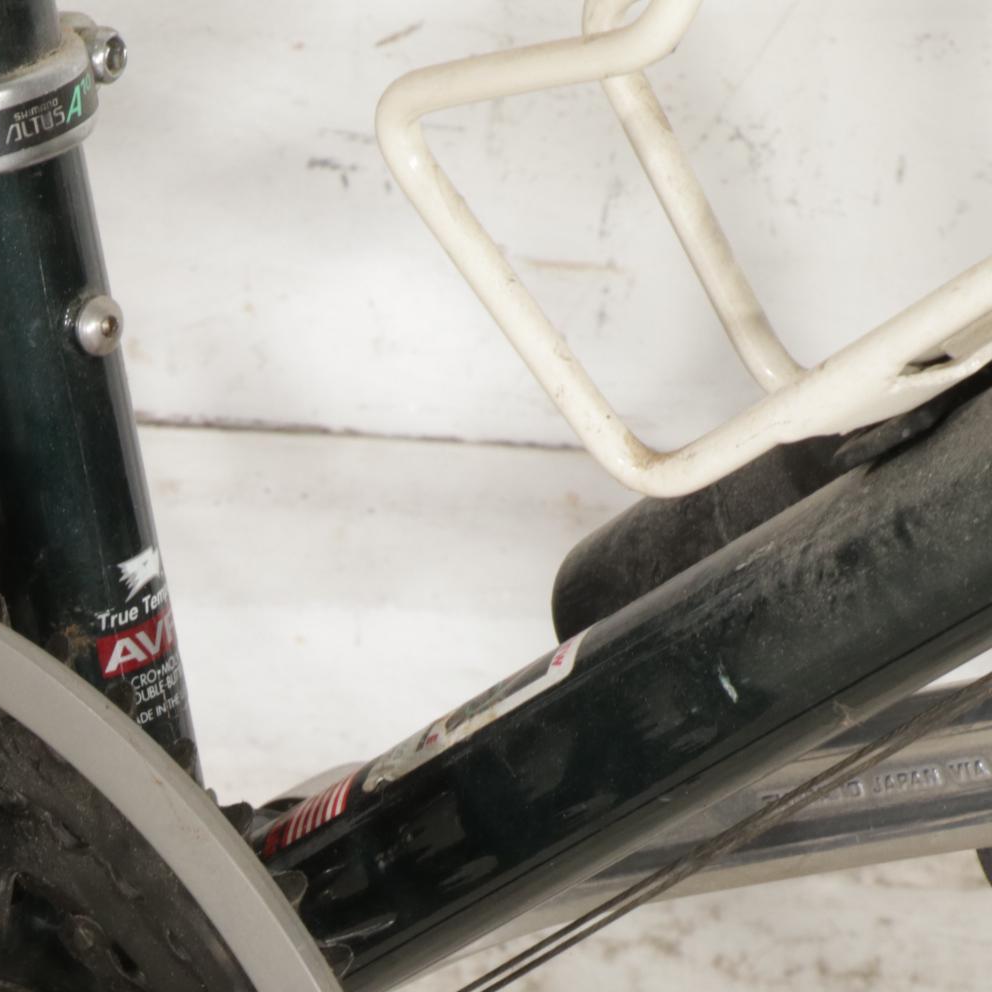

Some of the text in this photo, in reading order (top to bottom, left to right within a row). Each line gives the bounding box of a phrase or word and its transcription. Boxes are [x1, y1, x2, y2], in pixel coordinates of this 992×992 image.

[13, 97, 58, 121] SHIMANO
[5, 105, 66, 145] ALTUS
[96, 607, 139, 631] True
[871, 766, 943, 794] JAPAN
